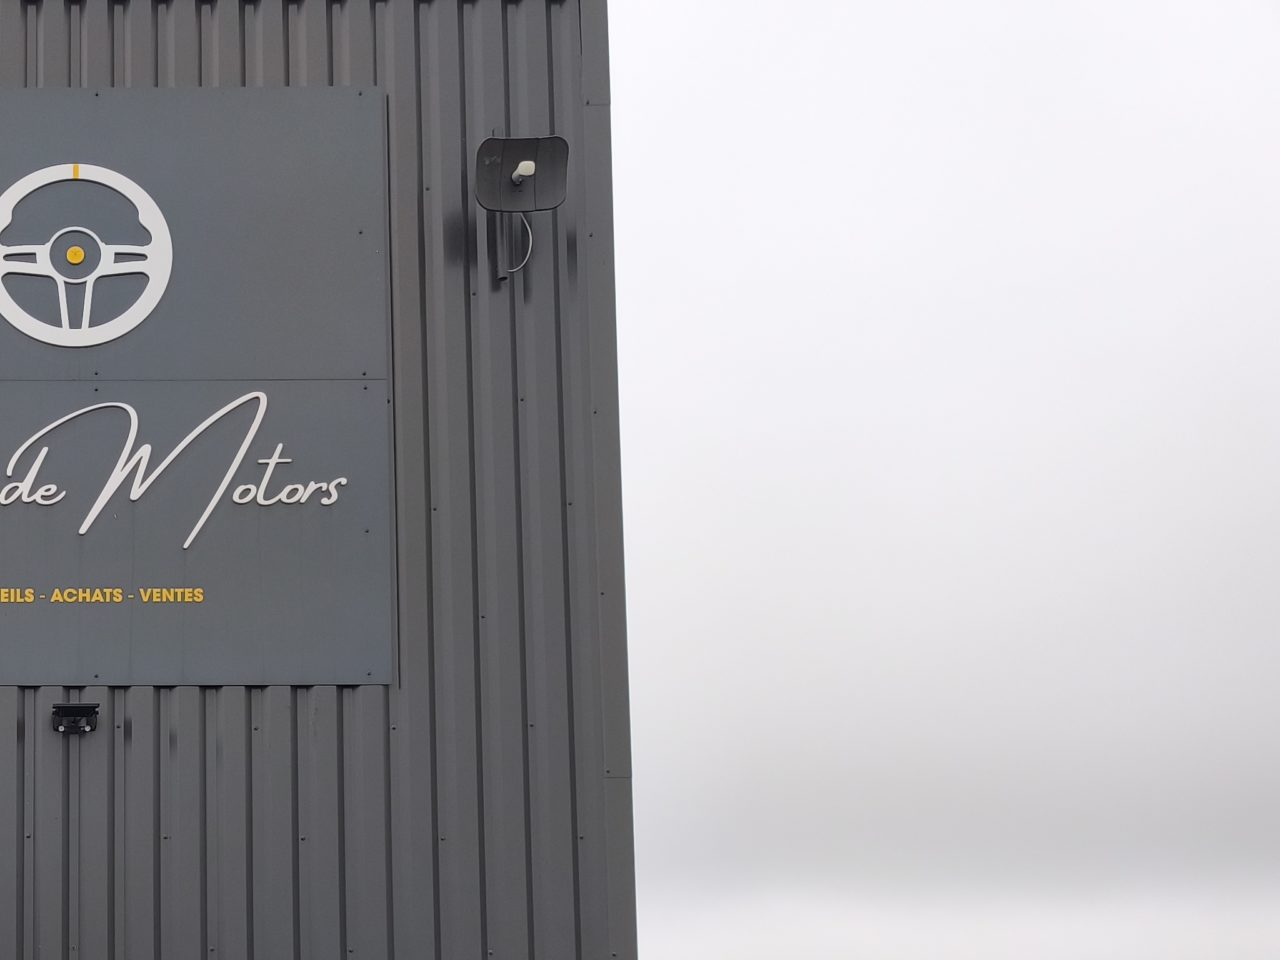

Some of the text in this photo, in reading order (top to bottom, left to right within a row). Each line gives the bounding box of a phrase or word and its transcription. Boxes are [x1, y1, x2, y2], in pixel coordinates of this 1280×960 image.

[7, 391, 348, 549] Motors
[50, 587, 123, 603] ACHATS
[139, 587, 204, 603] VENTES
